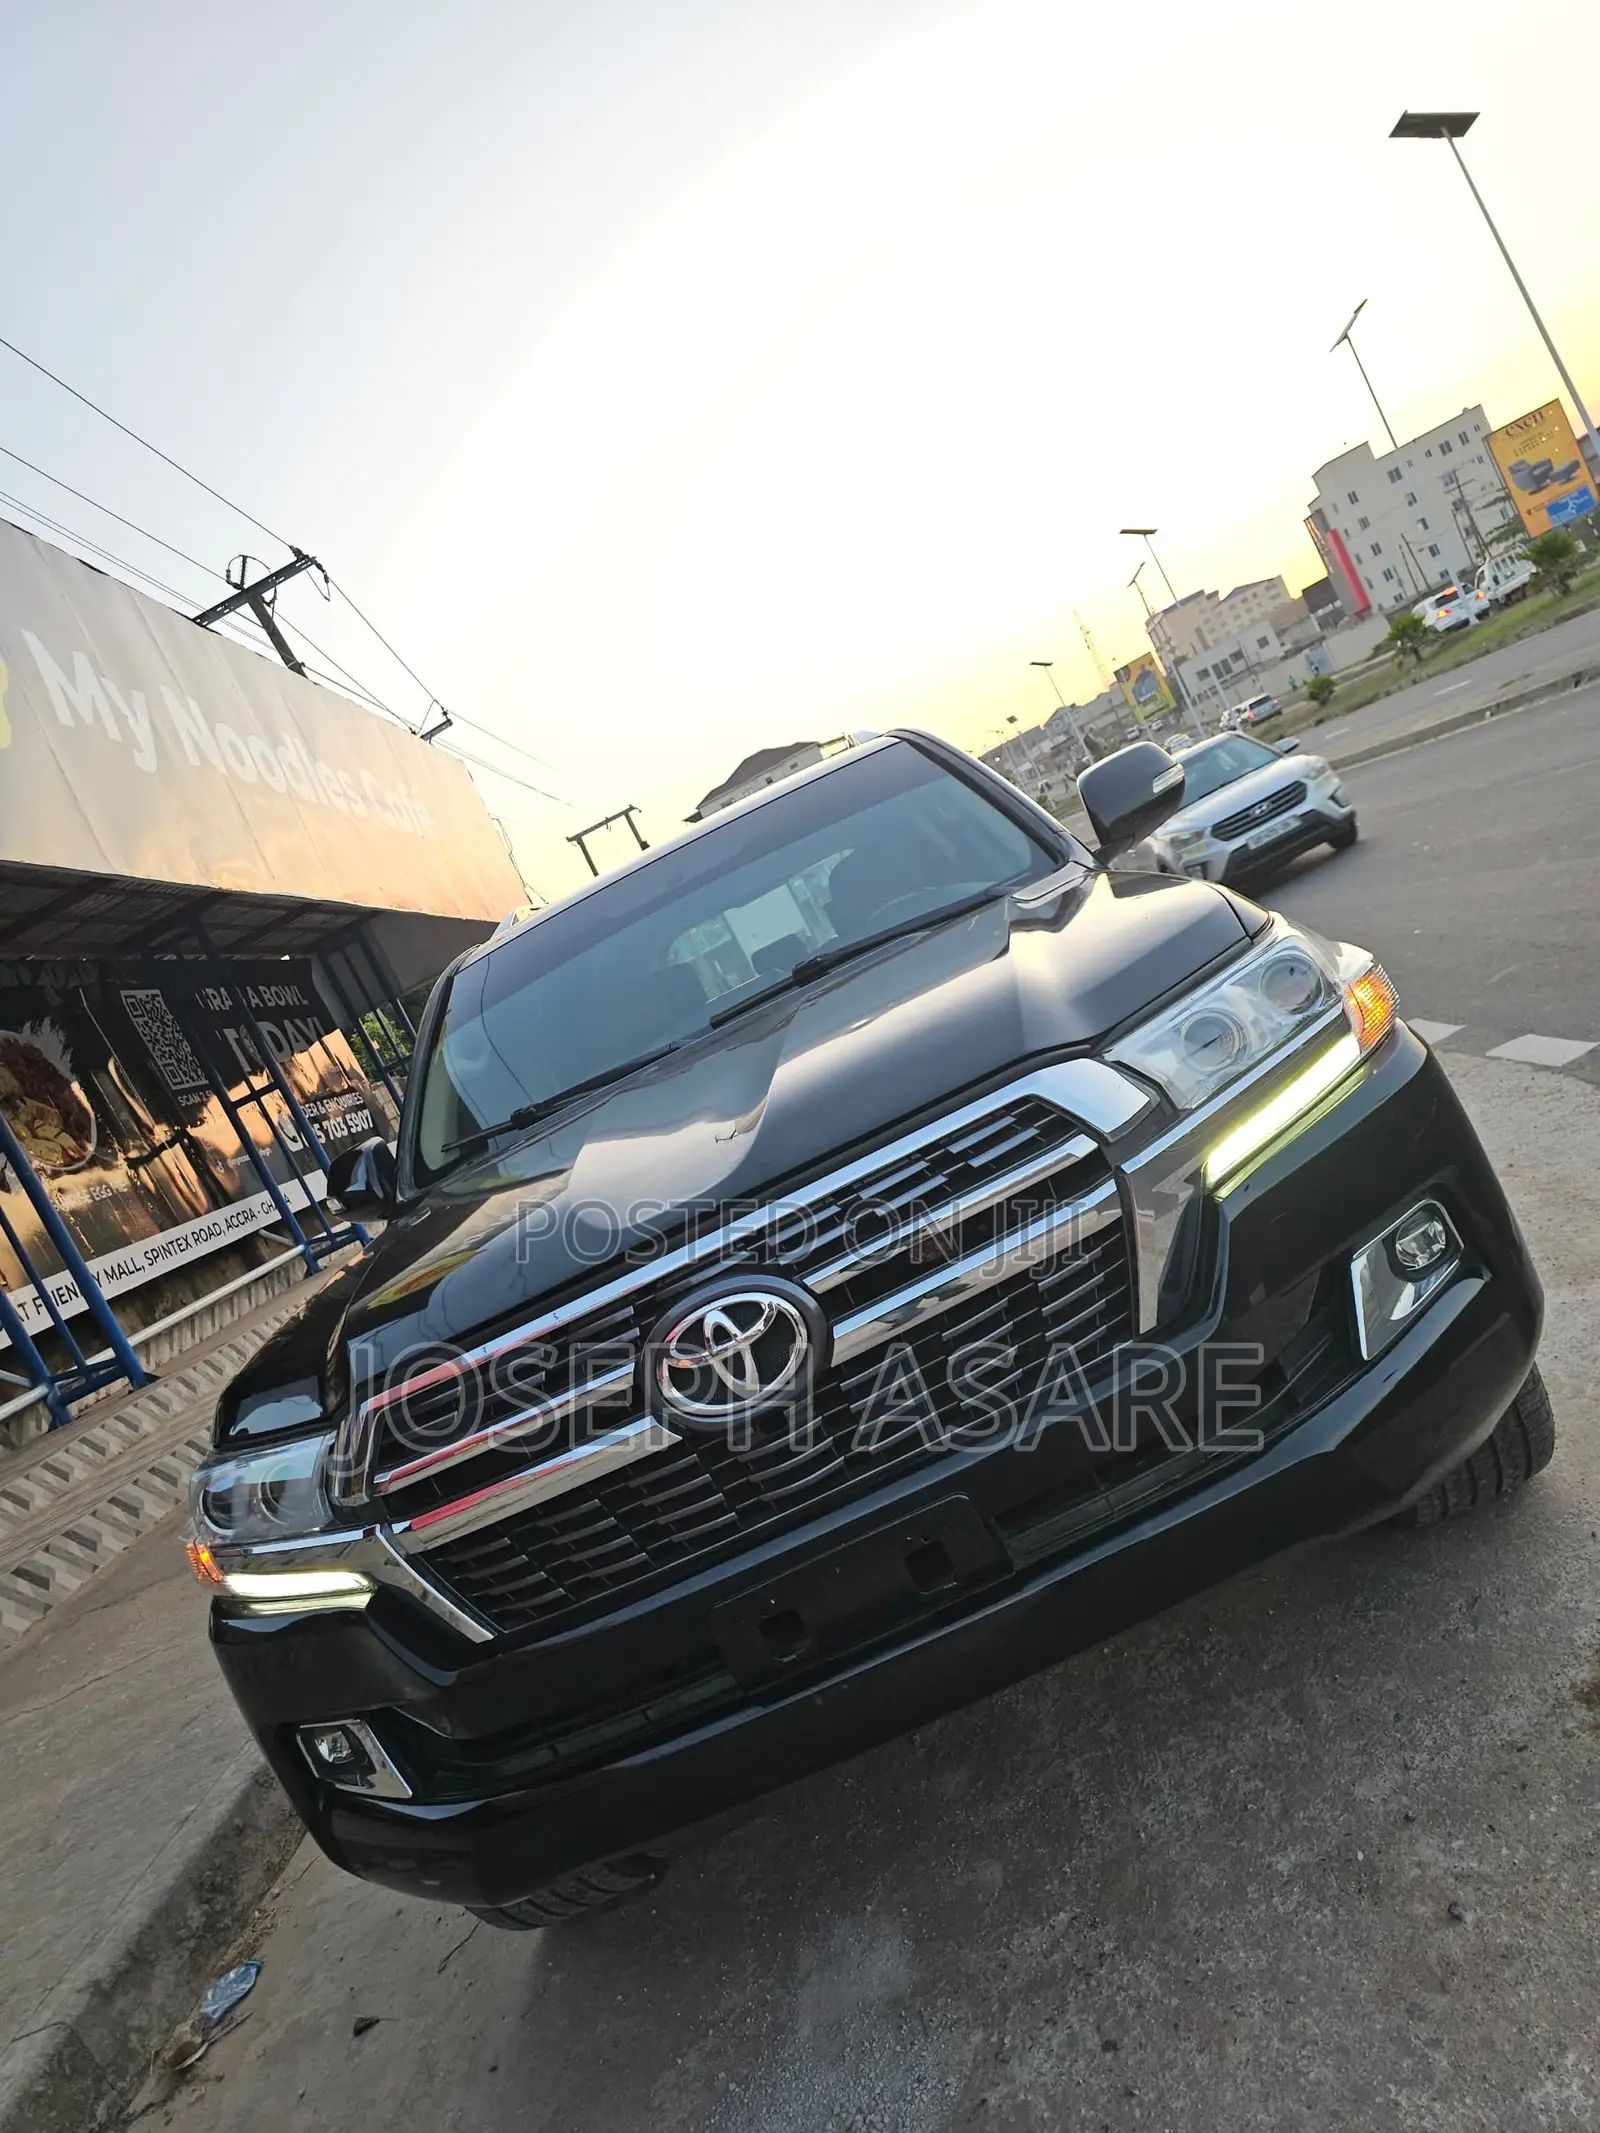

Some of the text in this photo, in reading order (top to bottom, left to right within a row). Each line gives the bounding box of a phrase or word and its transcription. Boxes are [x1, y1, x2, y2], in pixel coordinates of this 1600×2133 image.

[20, 628, 158, 773] My
[158, 684, 368, 818] Noodles
[258, 985, 309, 1007] BOWL
[323, 1092, 364, 1112] ENQUIRIES
[345, 1109, 373, 1133] 5907
[103, 1257, 146, 1284] MALL,
[144, 1234, 192, 1267] SPINTEX
[191, 1222, 226, 1247] ROAD,
[224, 1208, 258, 1232] ACCRA
